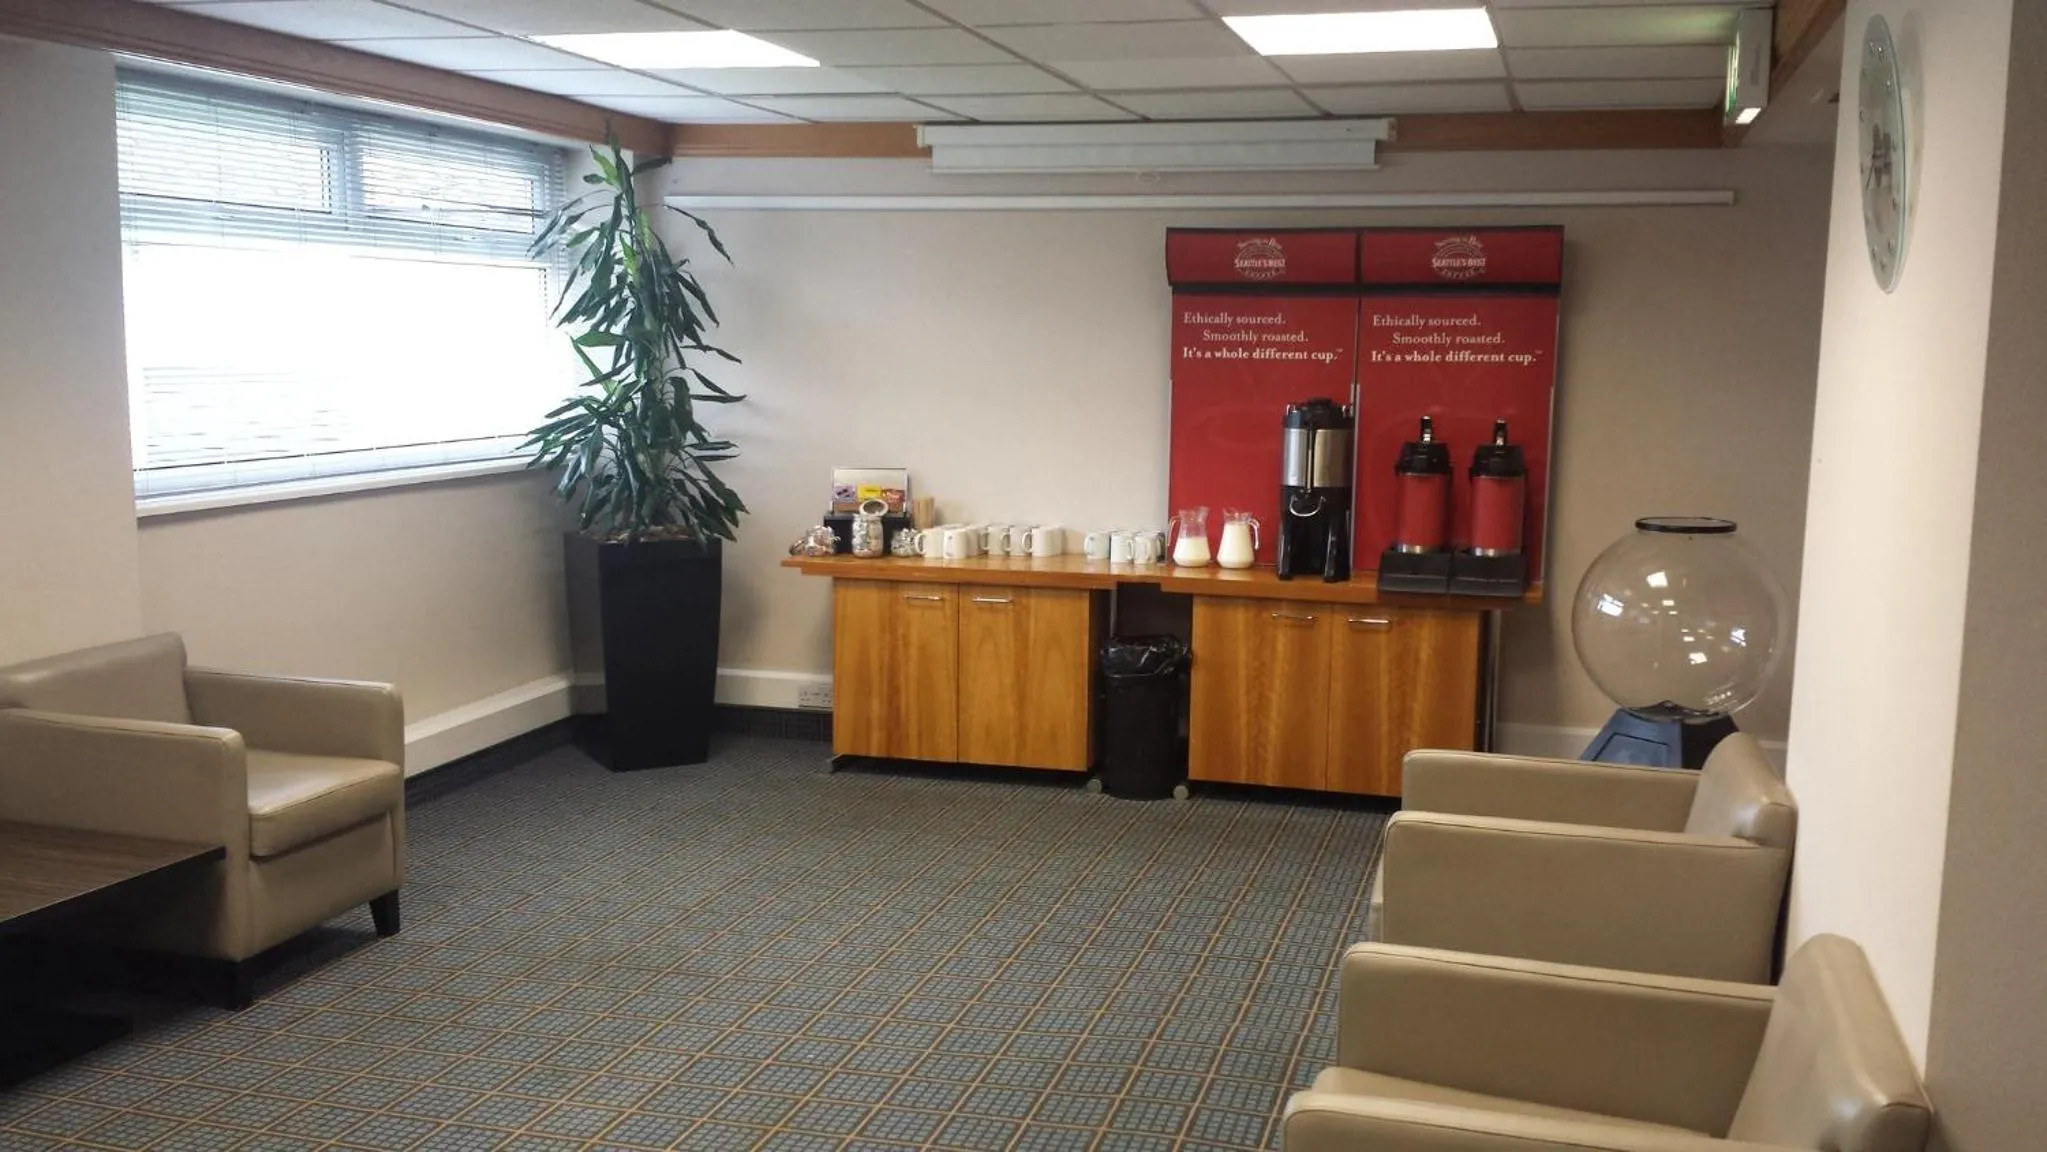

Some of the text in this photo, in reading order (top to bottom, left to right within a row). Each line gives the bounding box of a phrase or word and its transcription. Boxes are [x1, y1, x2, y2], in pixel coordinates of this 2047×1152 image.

[1183, 311, 1286, 328] Ethically sourced.
[1373, 314, 1481, 329] Ethically sourced.
[1202, 329, 1309, 344] Smoothly roasted.
[1392, 332, 1505, 346] Smoothly roasted.
[1183, 347, 1201, 359] It's
[1204, 351, 1212, 359] a
[1214, 347, 1250, 359] whole
[1252, 347, 1308, 360] different
[1371, 350, 1391, 362] It's
[1394, 354, 1401, 363] a
[1404, 350, 1442, 362] whole
[1445, 350, 1504, 363] different
